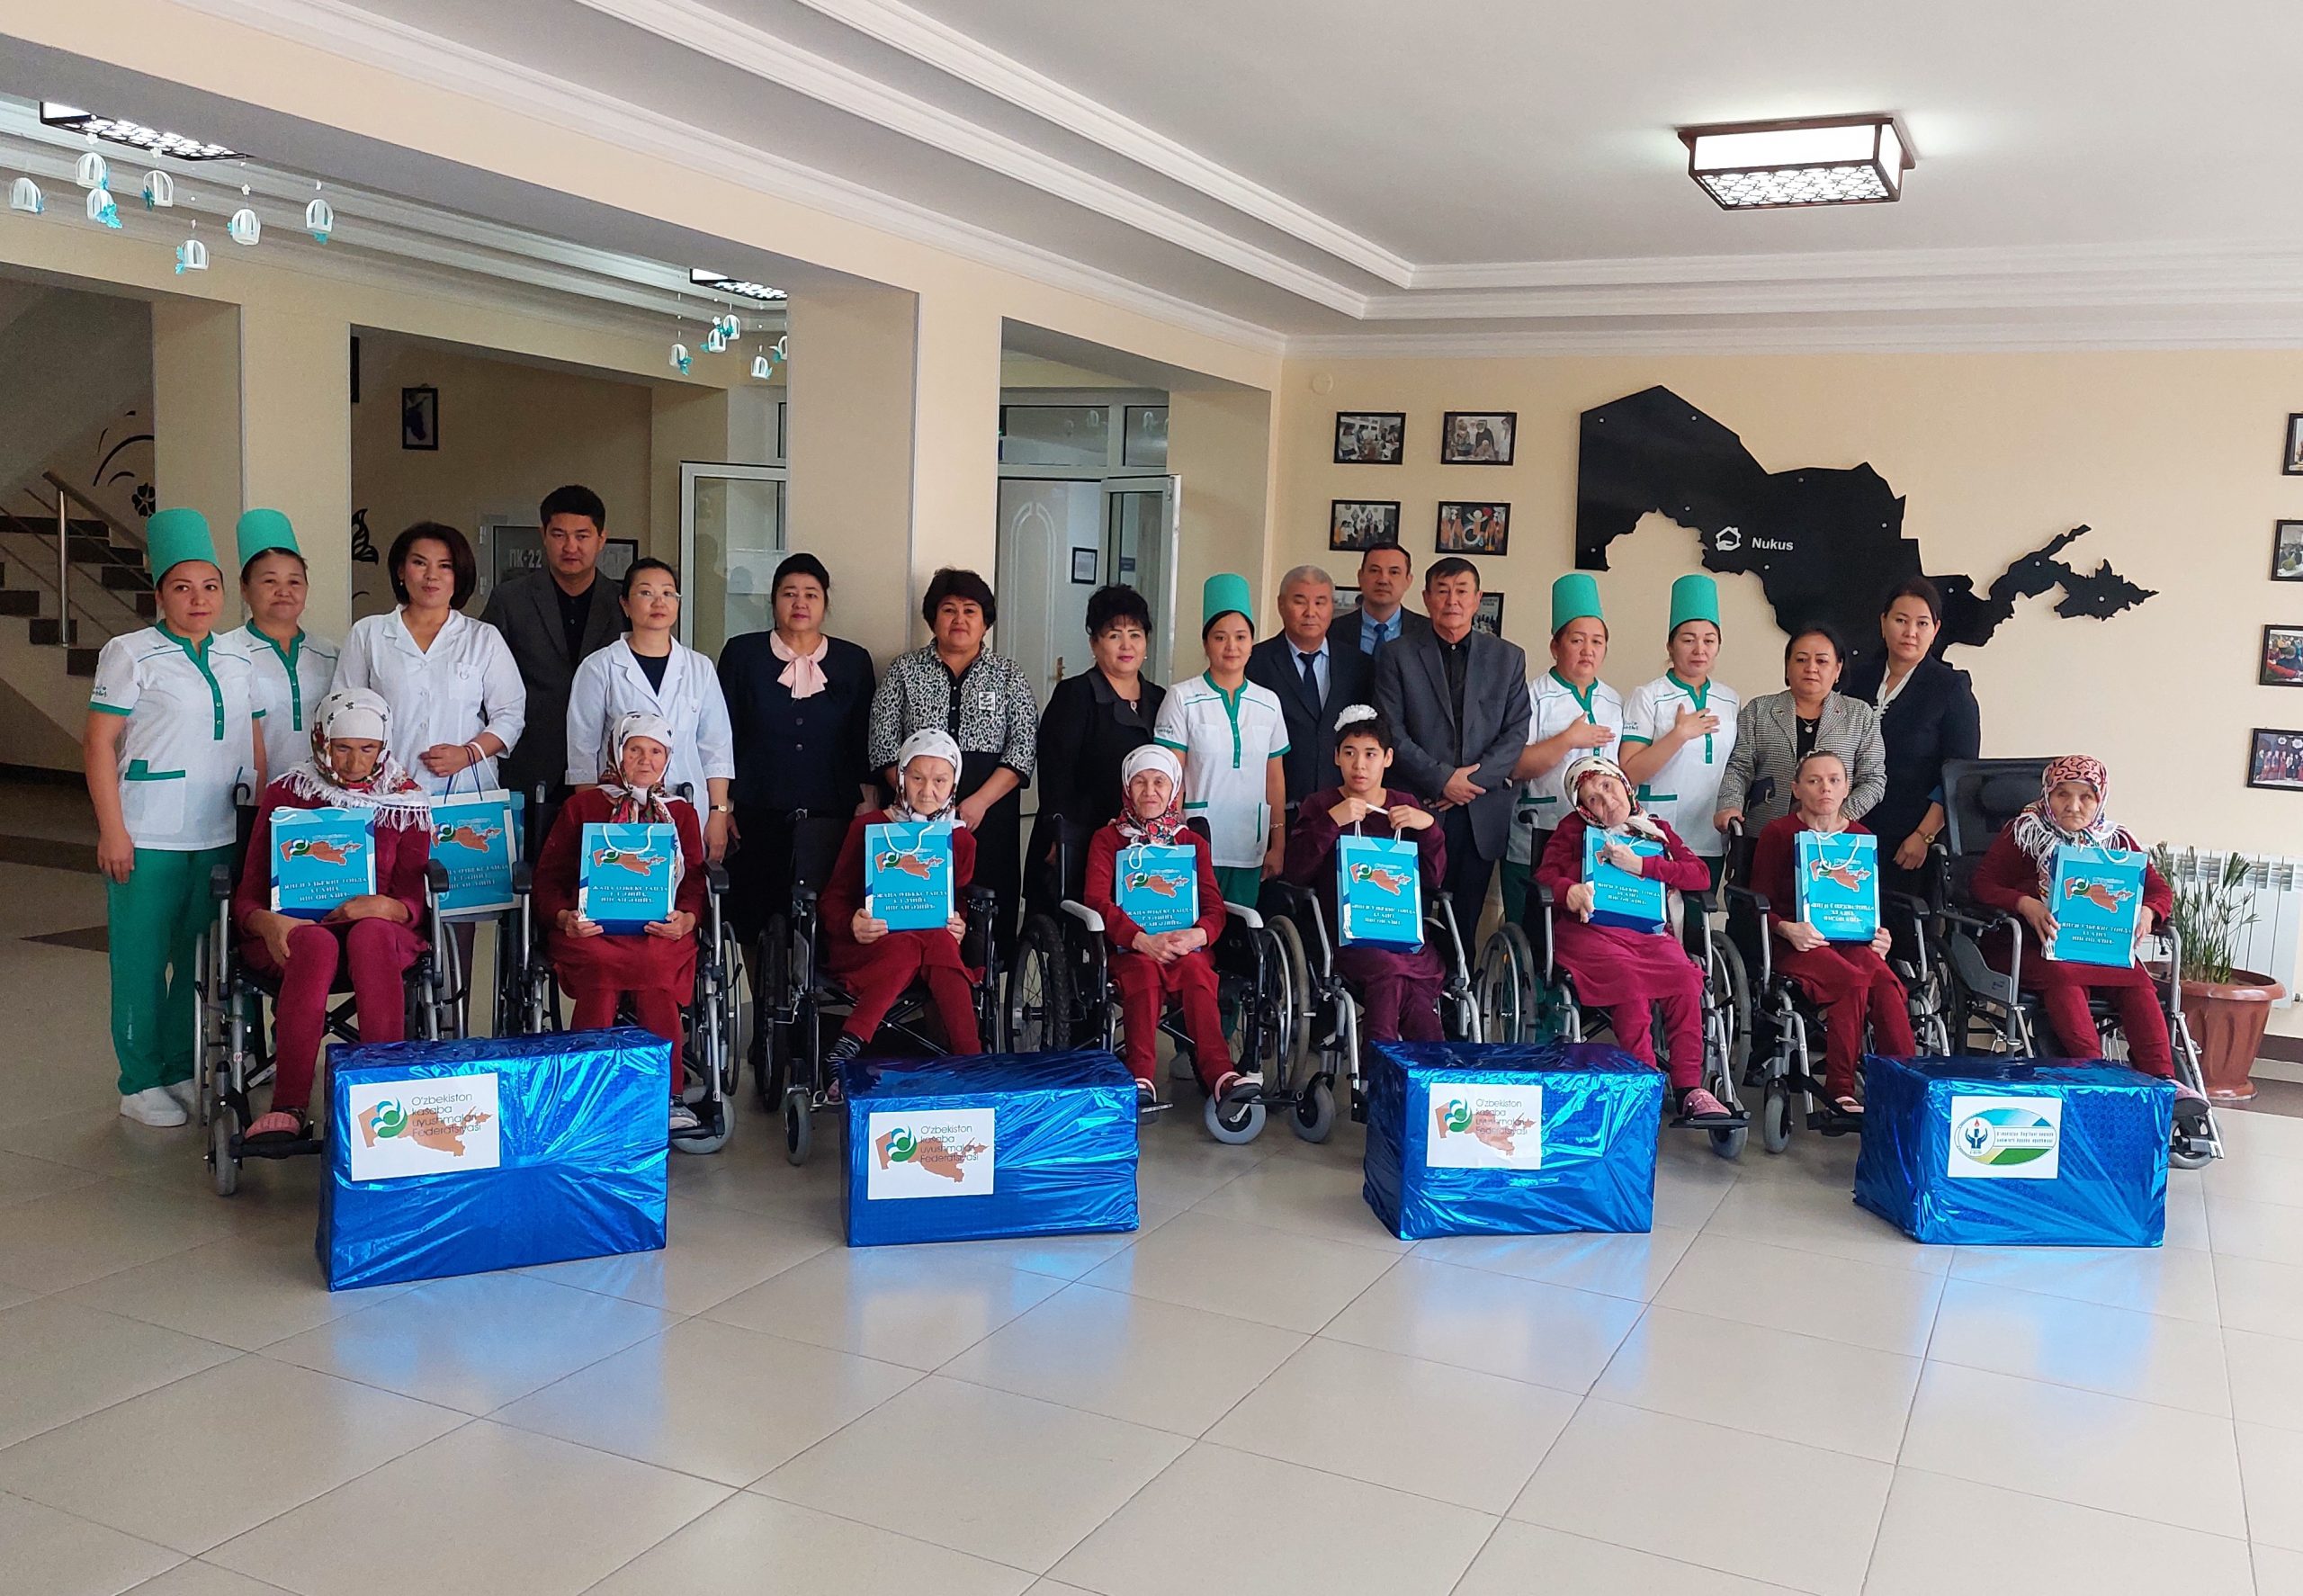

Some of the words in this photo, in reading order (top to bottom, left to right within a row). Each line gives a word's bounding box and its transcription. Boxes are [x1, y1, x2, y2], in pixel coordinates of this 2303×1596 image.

[1752, 537, 1794, 551] Nukus
[411, 1092, 473, 1107] O'zbekiston
[1475, 1098, 1522, 1108] O'zbekiston
[411, 1105, 453, 1116] kasaba
[920, 1125, 972, 1134] O'zbekiston
